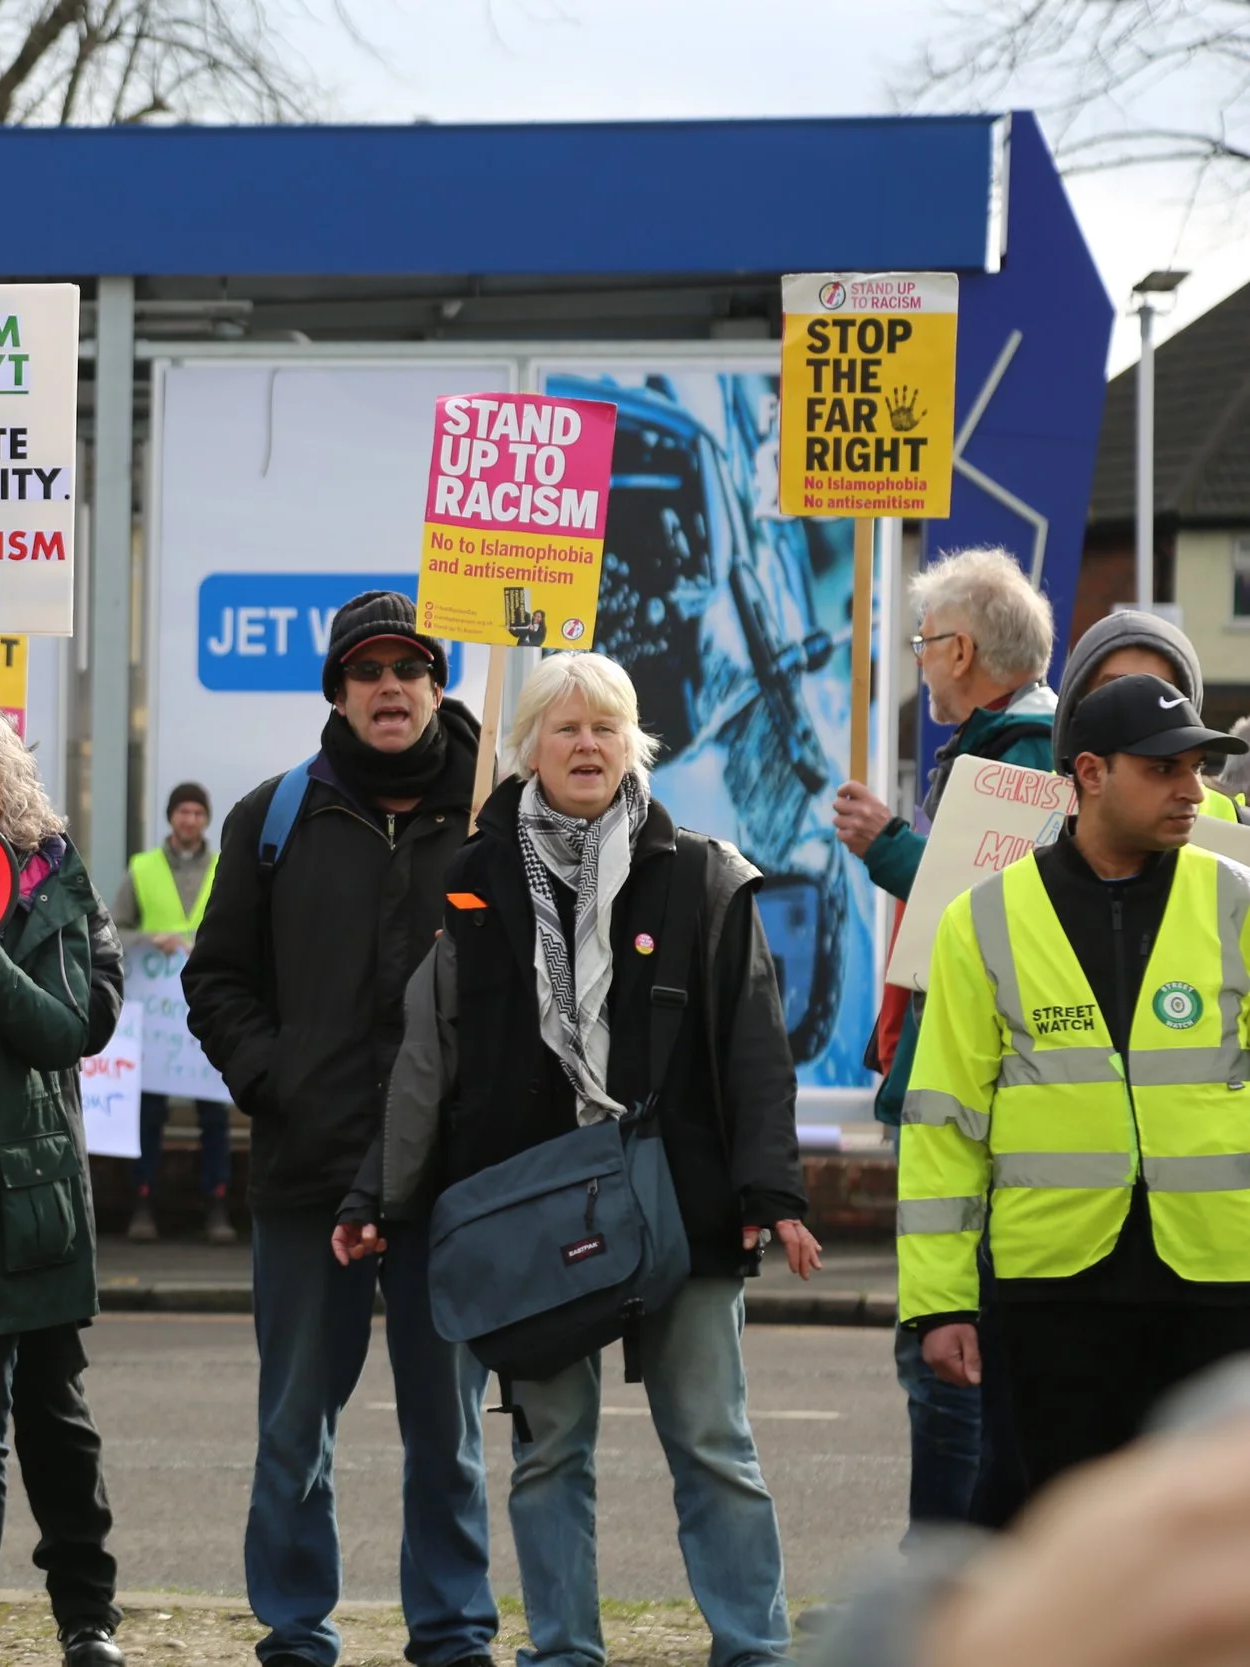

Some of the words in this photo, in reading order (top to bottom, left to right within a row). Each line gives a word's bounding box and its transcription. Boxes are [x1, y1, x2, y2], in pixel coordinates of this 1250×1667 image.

[851, 282, 894, 296] STAND
[897, 282, 916, 295] UP
[852, 297, 868, 309] TO
[871, 296, 922, 309] RACISM
[806, 318, 913, 354] STOP
[806, 358, 882, 394] THE
[443, 398, 582, 446] STAND
[806, 397, 878, 433] FAR
[439, 435, 499, 479] UP
[509, 443, 566, 486] TO
[806, 436, 928, 473] RIGHT
[803, 494, 823, 508] No
[827, 495, 925, 509] antisemitism
[804, 476, 824, 490] No
[827, 476, 927, 494] Islamophobia
[434, 475, 599, 529] RACISM
[431, 532, 454, 551] No
[459, 537, 475, 554] to
[481, 538, 594, 565] Islamophobia
[428, 557, 459, 575] and
[463, 562, 574, 586] antisemitism
[207, 606, 298, 656] JET
[1032, 1003, 1096, 1021] STREET
[1036, 1018, 1095, 1035] WATCH
[568, 1241, 599, 1257] EASTPAK
